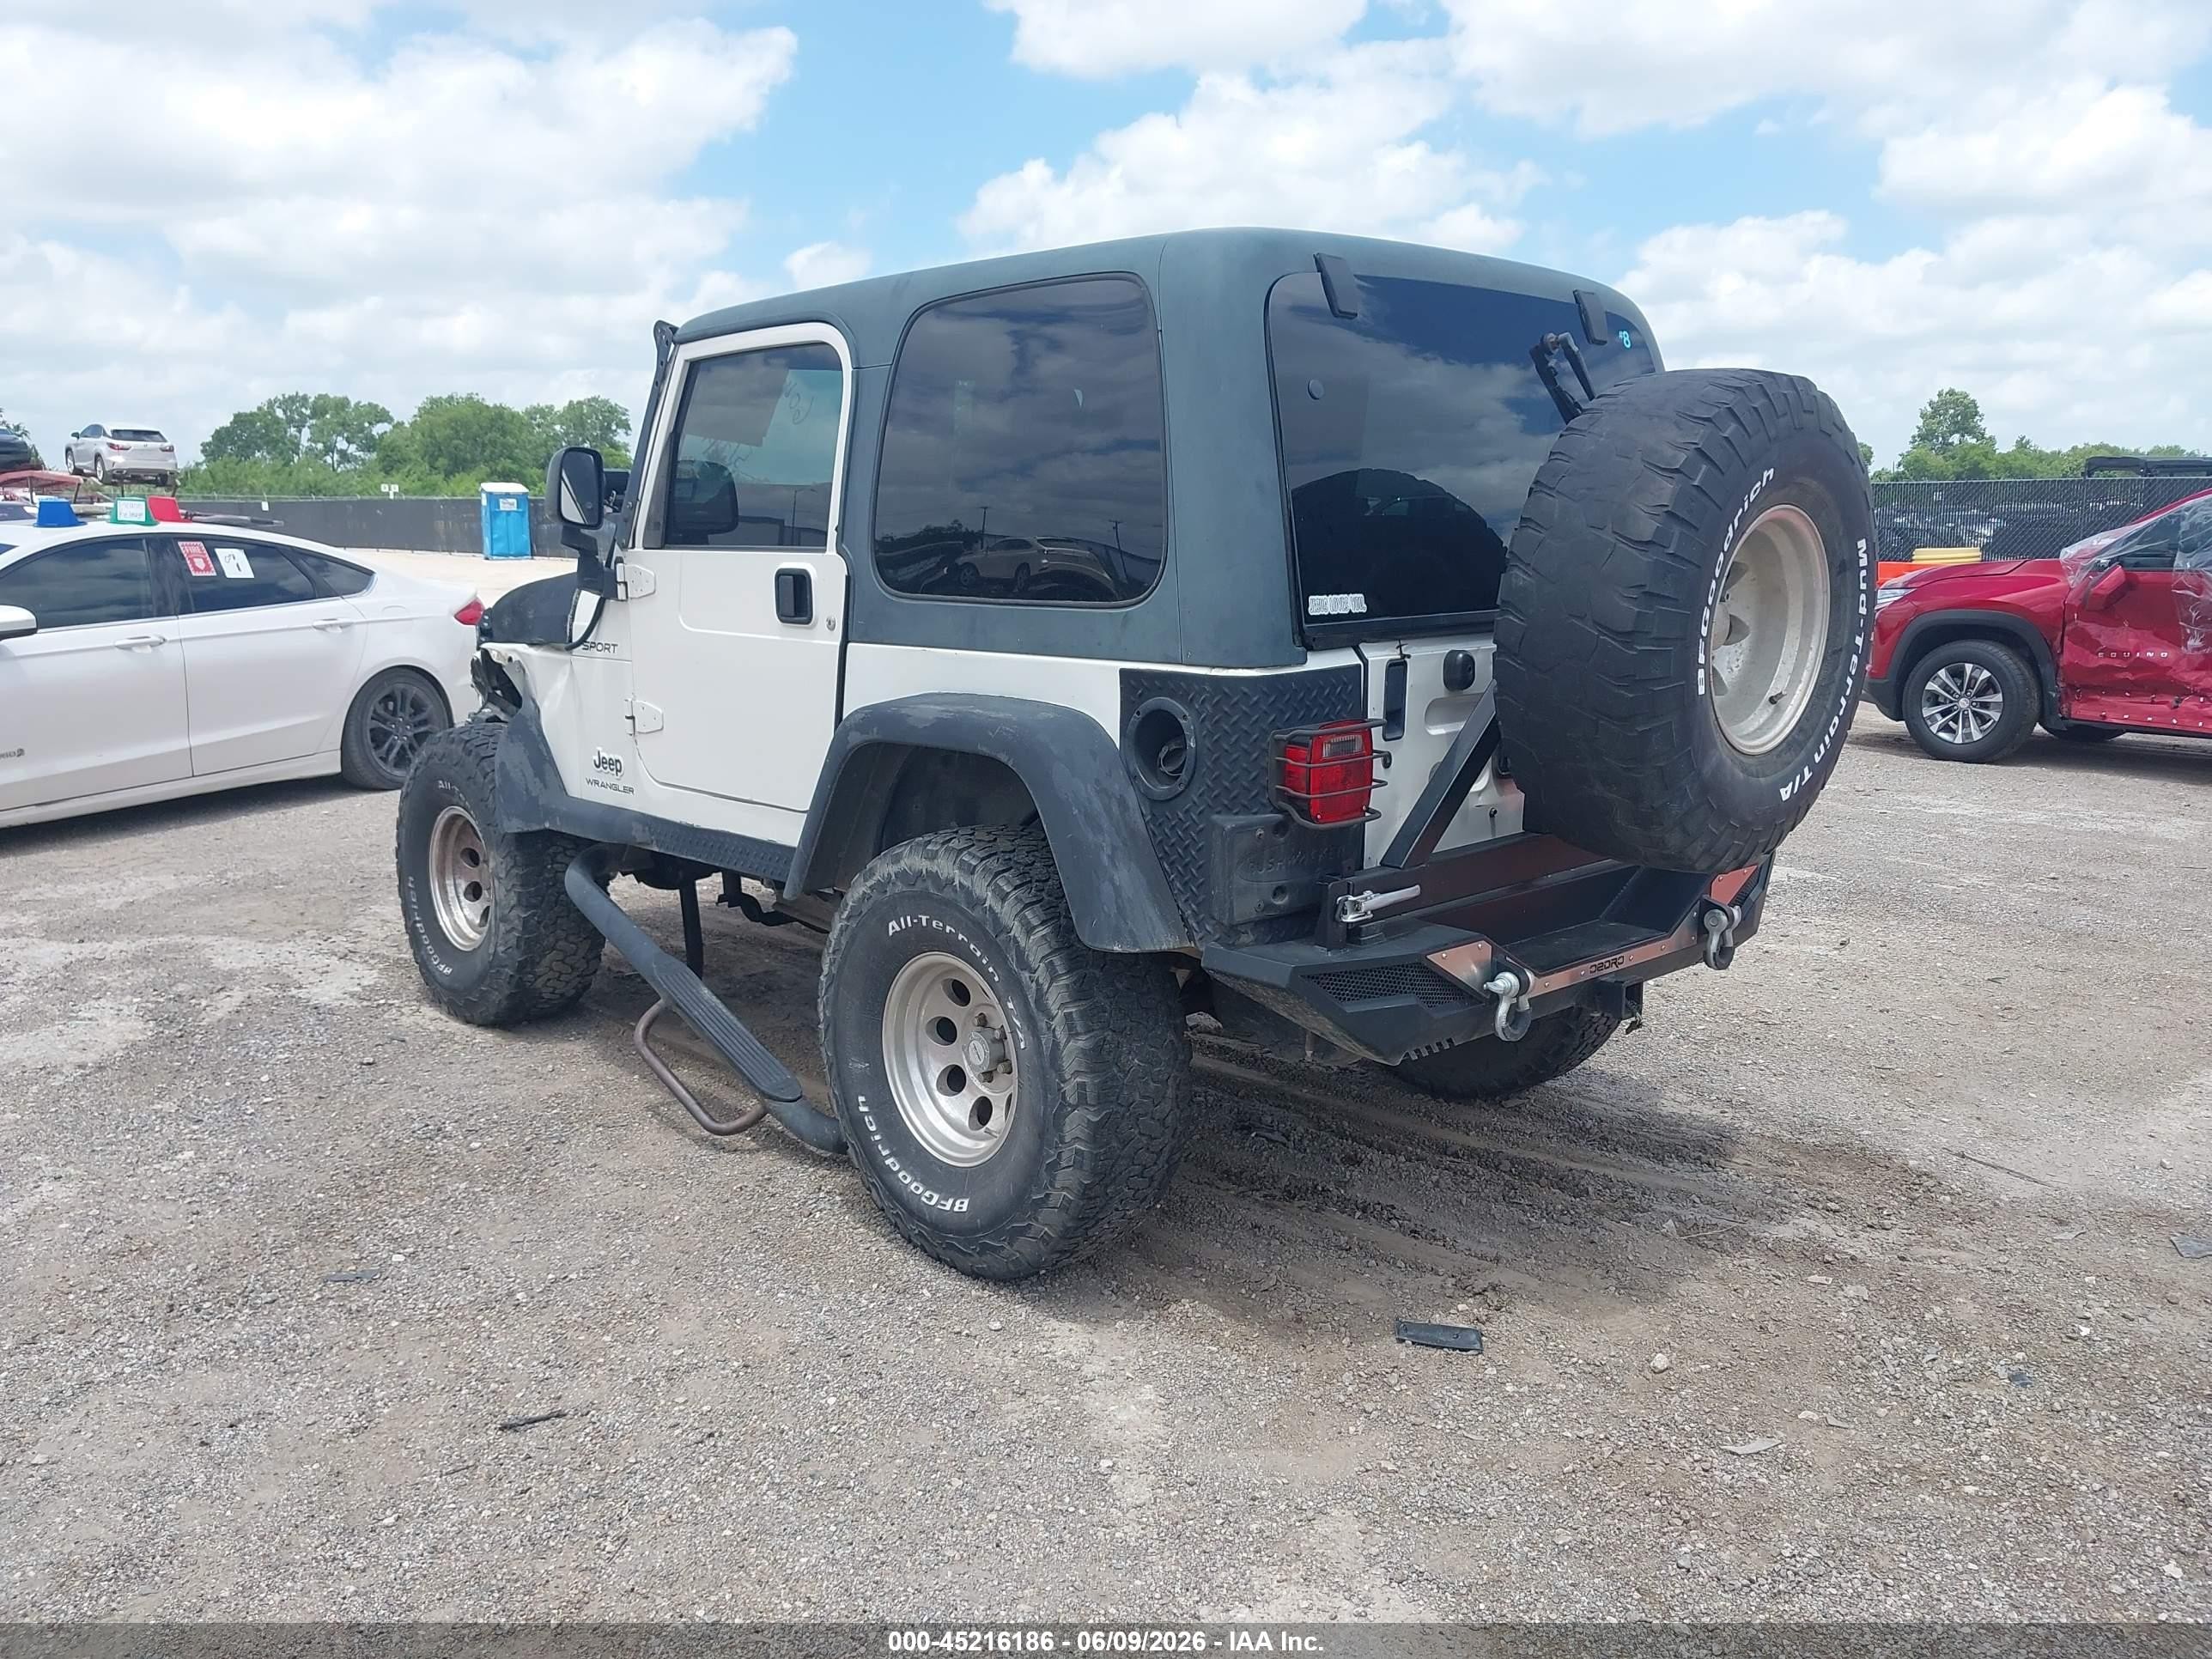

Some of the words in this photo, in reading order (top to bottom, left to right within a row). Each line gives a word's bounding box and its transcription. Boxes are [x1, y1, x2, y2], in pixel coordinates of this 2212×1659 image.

[1697, 466, 1775, 696] BFGoodrich
[581, 641, 618, 654] SPORT
[1813, 538, 1868, 763] Mud-Terrain
[585, 777, 635, 795] WRANGLER
[593, 750, 623, 776] Jeep
[1779, 767, 1814, 802] T/A
[887, 914, 1000, 983] All-Terrain
[858, 1095, 970, 1212] BFGoodrich
